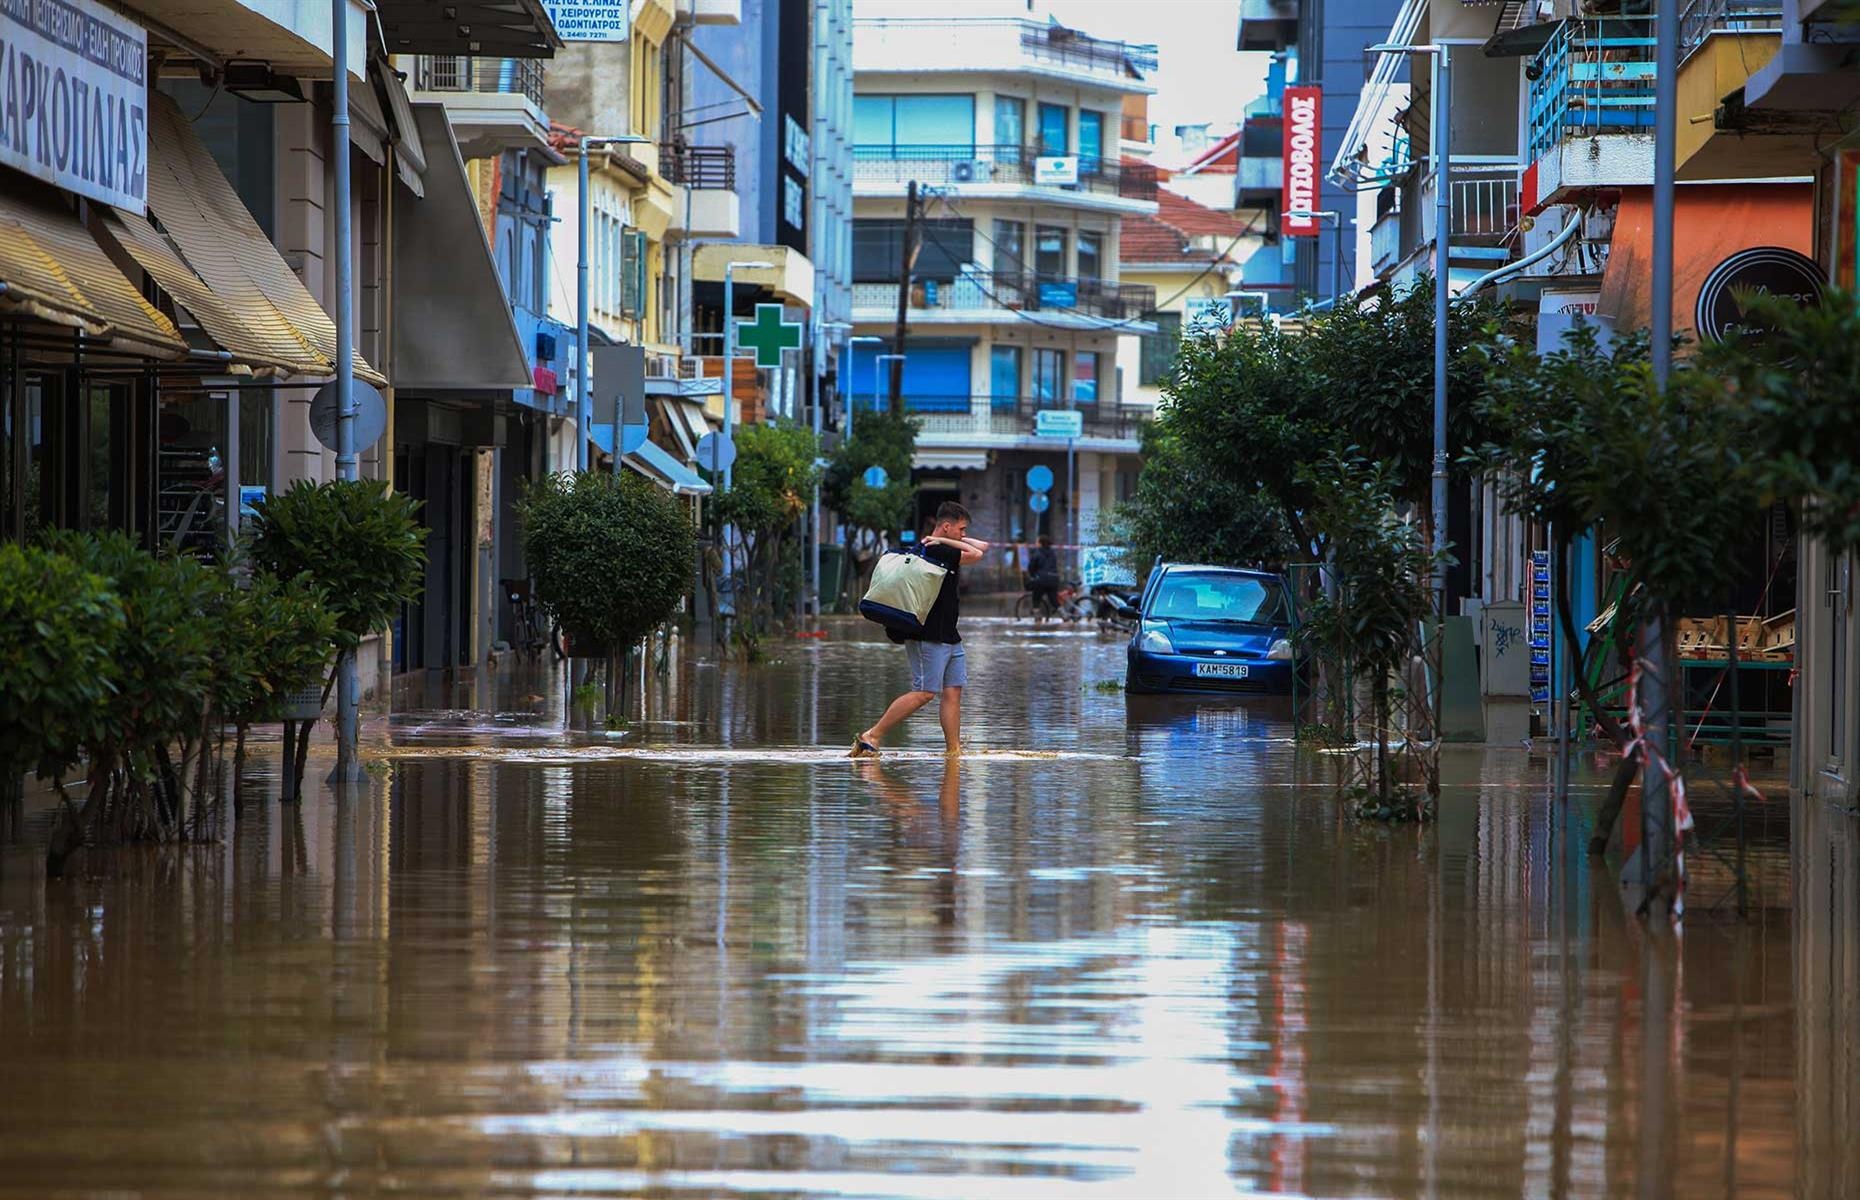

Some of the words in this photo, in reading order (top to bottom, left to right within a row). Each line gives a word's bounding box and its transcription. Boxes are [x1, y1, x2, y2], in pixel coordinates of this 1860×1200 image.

[558, 19, 621, 29] ΟΔΟΝΤΙΑΤΡΟΣ
[561, 8, 620, 18] ΧΕΙΡΟΥΡΓΟΣ
[89, 22, 109, 63] ΕΙΔΗ
[1289, 97, 1315, 227] ΚΩΤΣΟΒΟΛΟΣ
